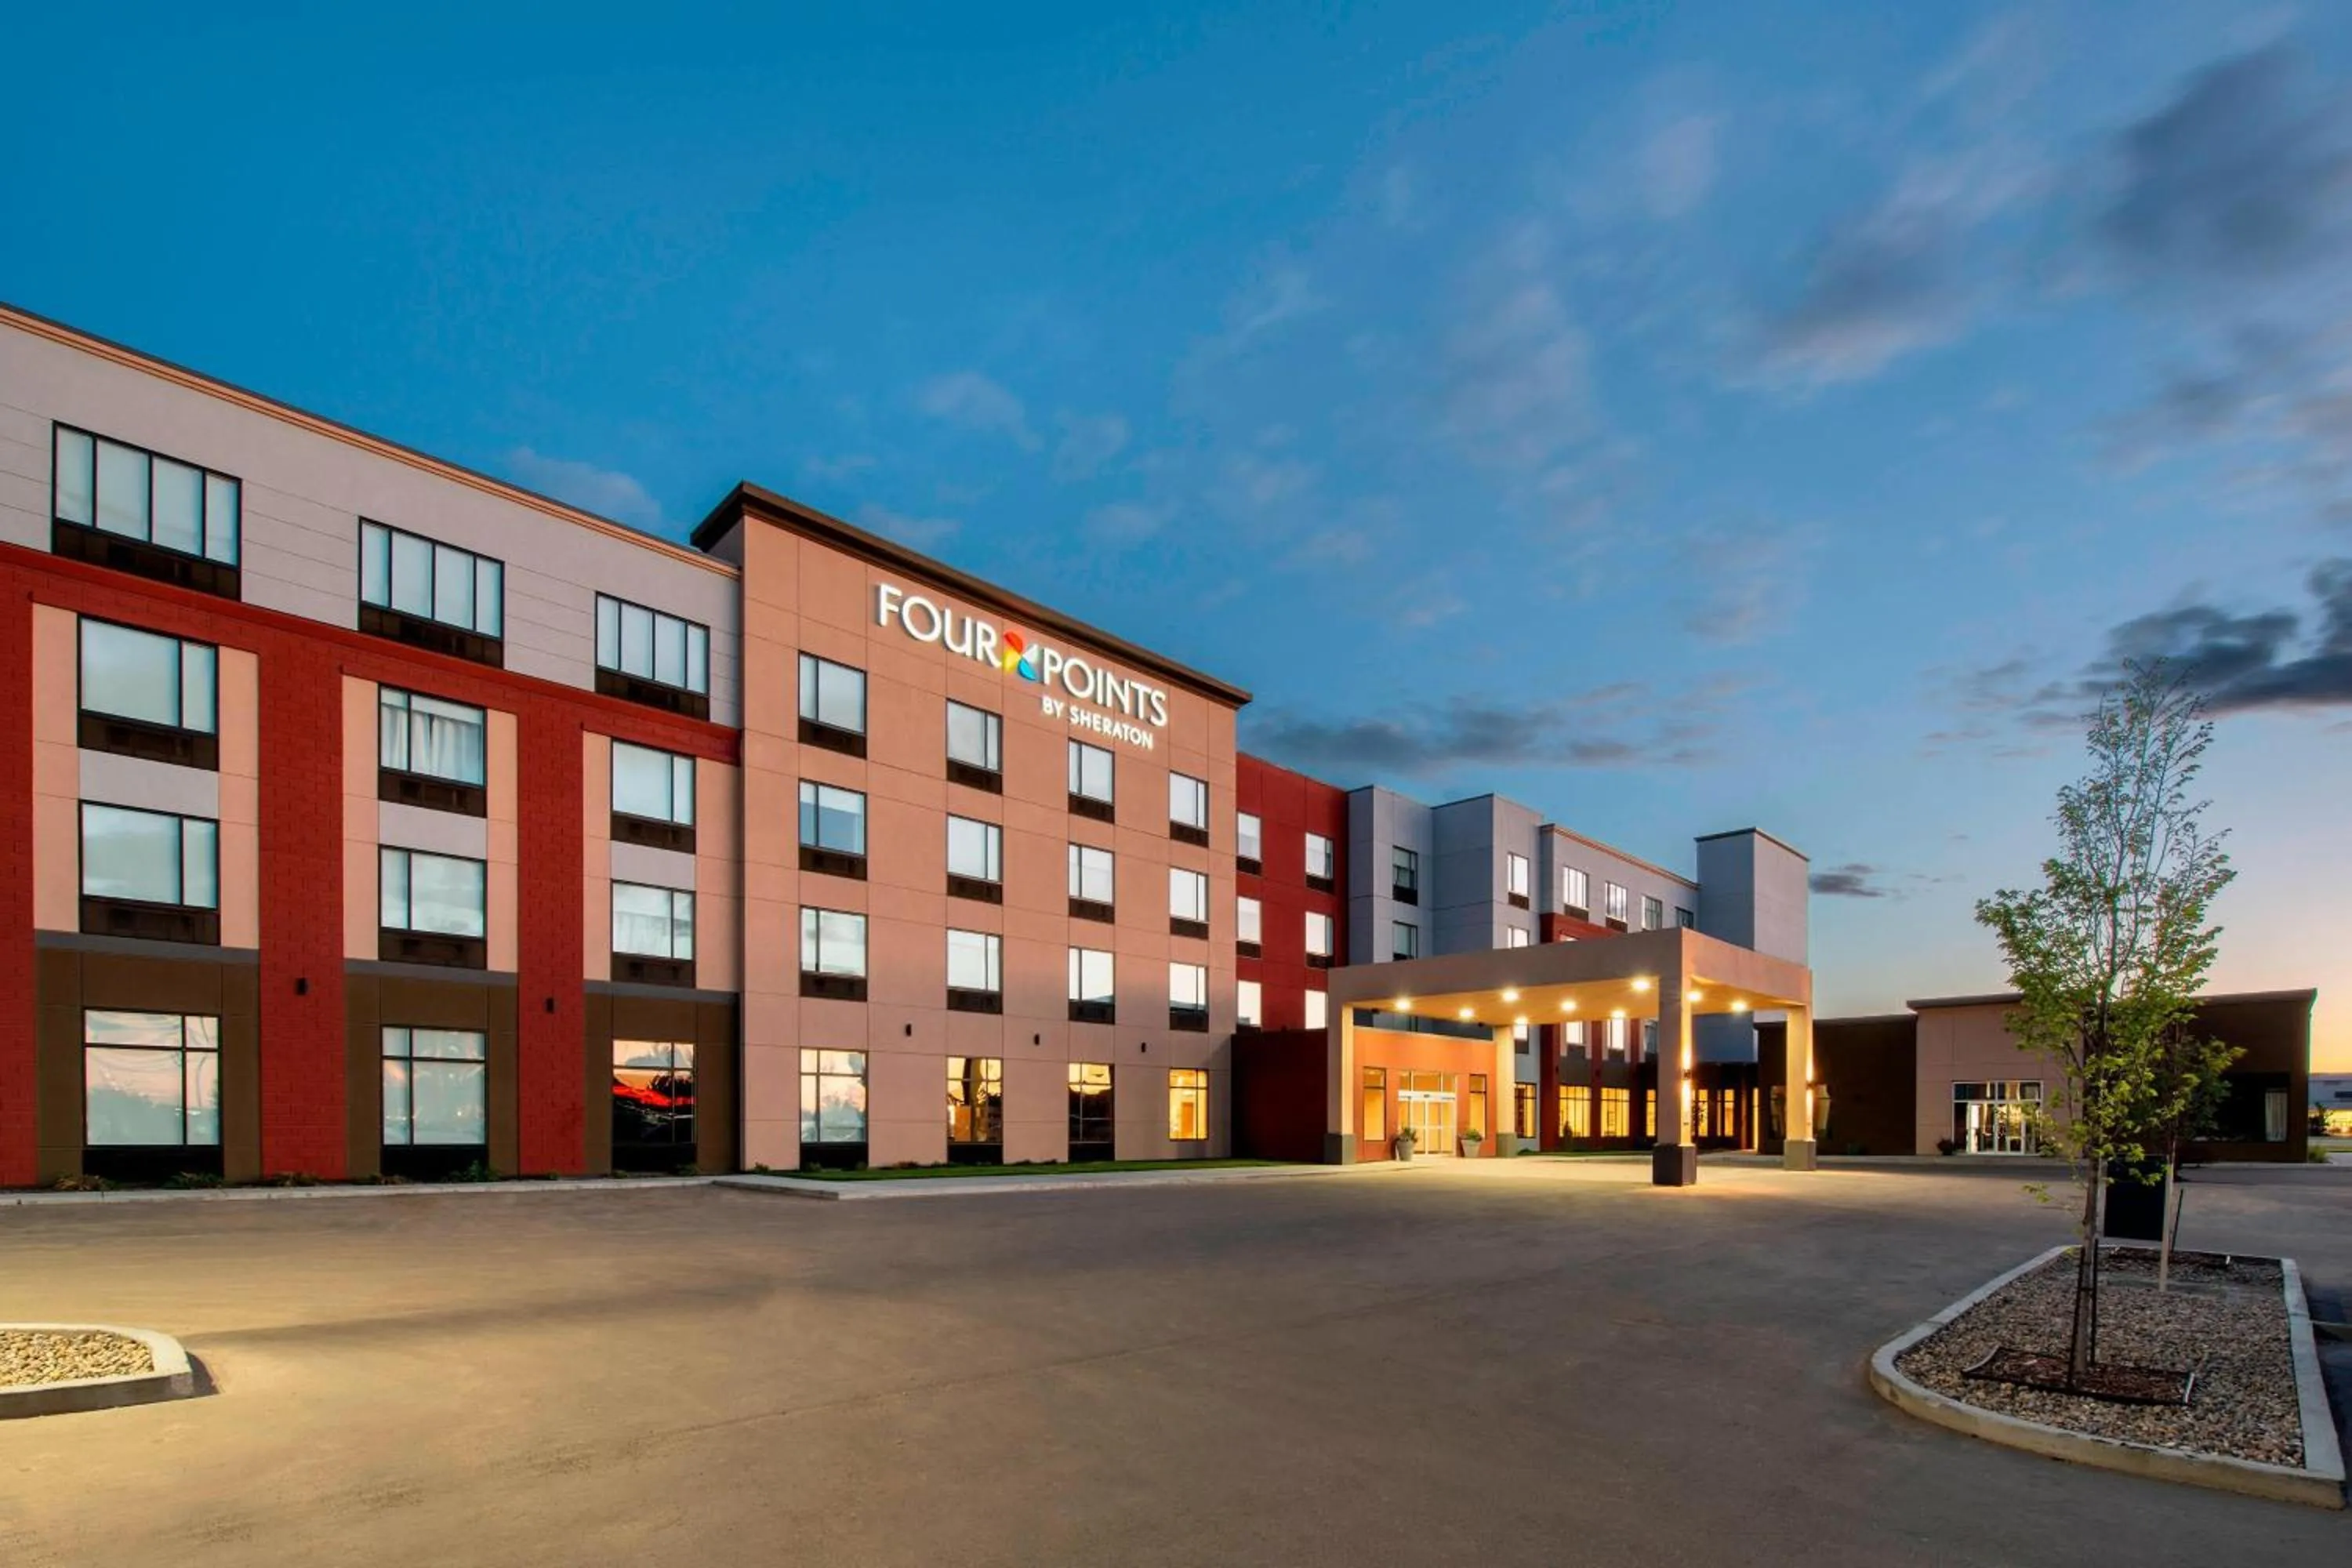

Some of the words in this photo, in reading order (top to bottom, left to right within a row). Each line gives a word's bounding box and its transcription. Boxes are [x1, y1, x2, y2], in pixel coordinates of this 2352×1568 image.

[878, 583, 1001, 668] FOUR
[1043, 648, 1167, 727] POINTS
[1042, 695, 1064, 717] BY
[1069, 706, 1153, 749] SHERATON
